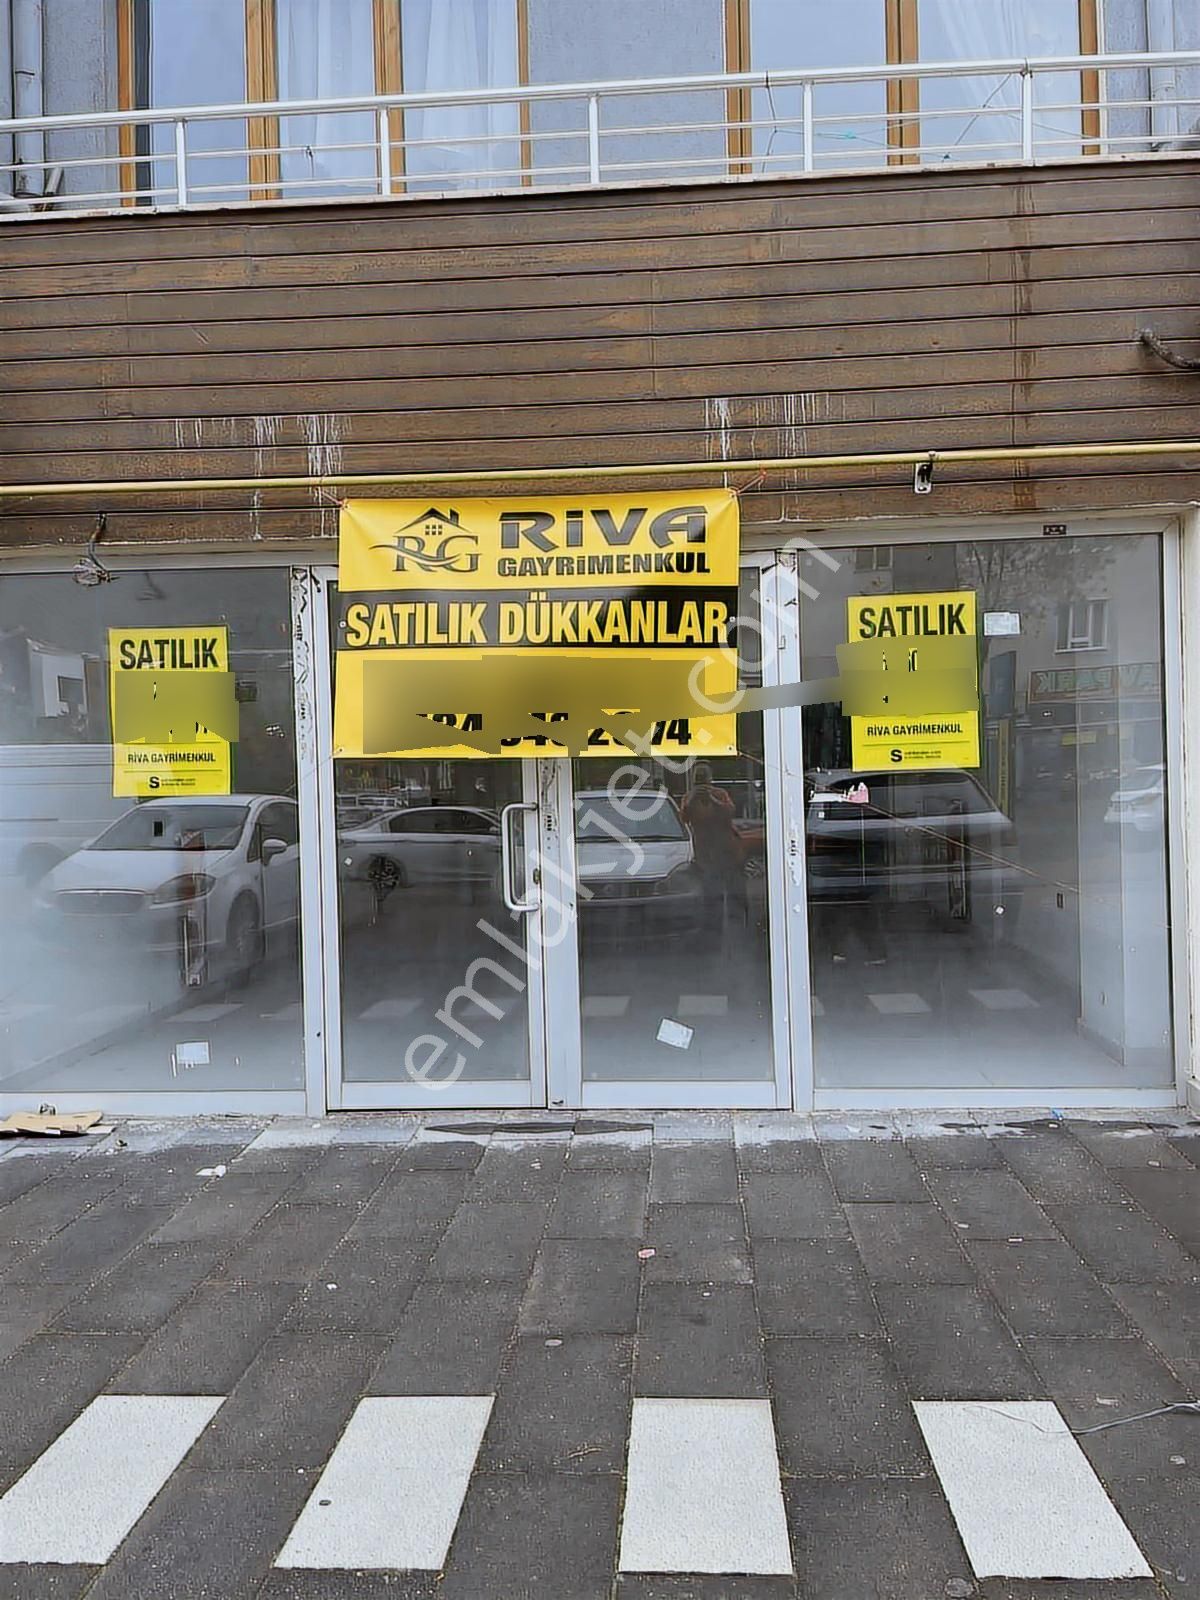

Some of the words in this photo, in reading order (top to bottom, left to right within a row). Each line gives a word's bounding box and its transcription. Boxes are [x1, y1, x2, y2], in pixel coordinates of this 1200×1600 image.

[346, 601, 488, 646] SATILIK
[499, 592, 729, 644] DÜKKANLAR
[859, 603, 967, 639] SATILIK
[119, 638, 219, 670] SATILIK
